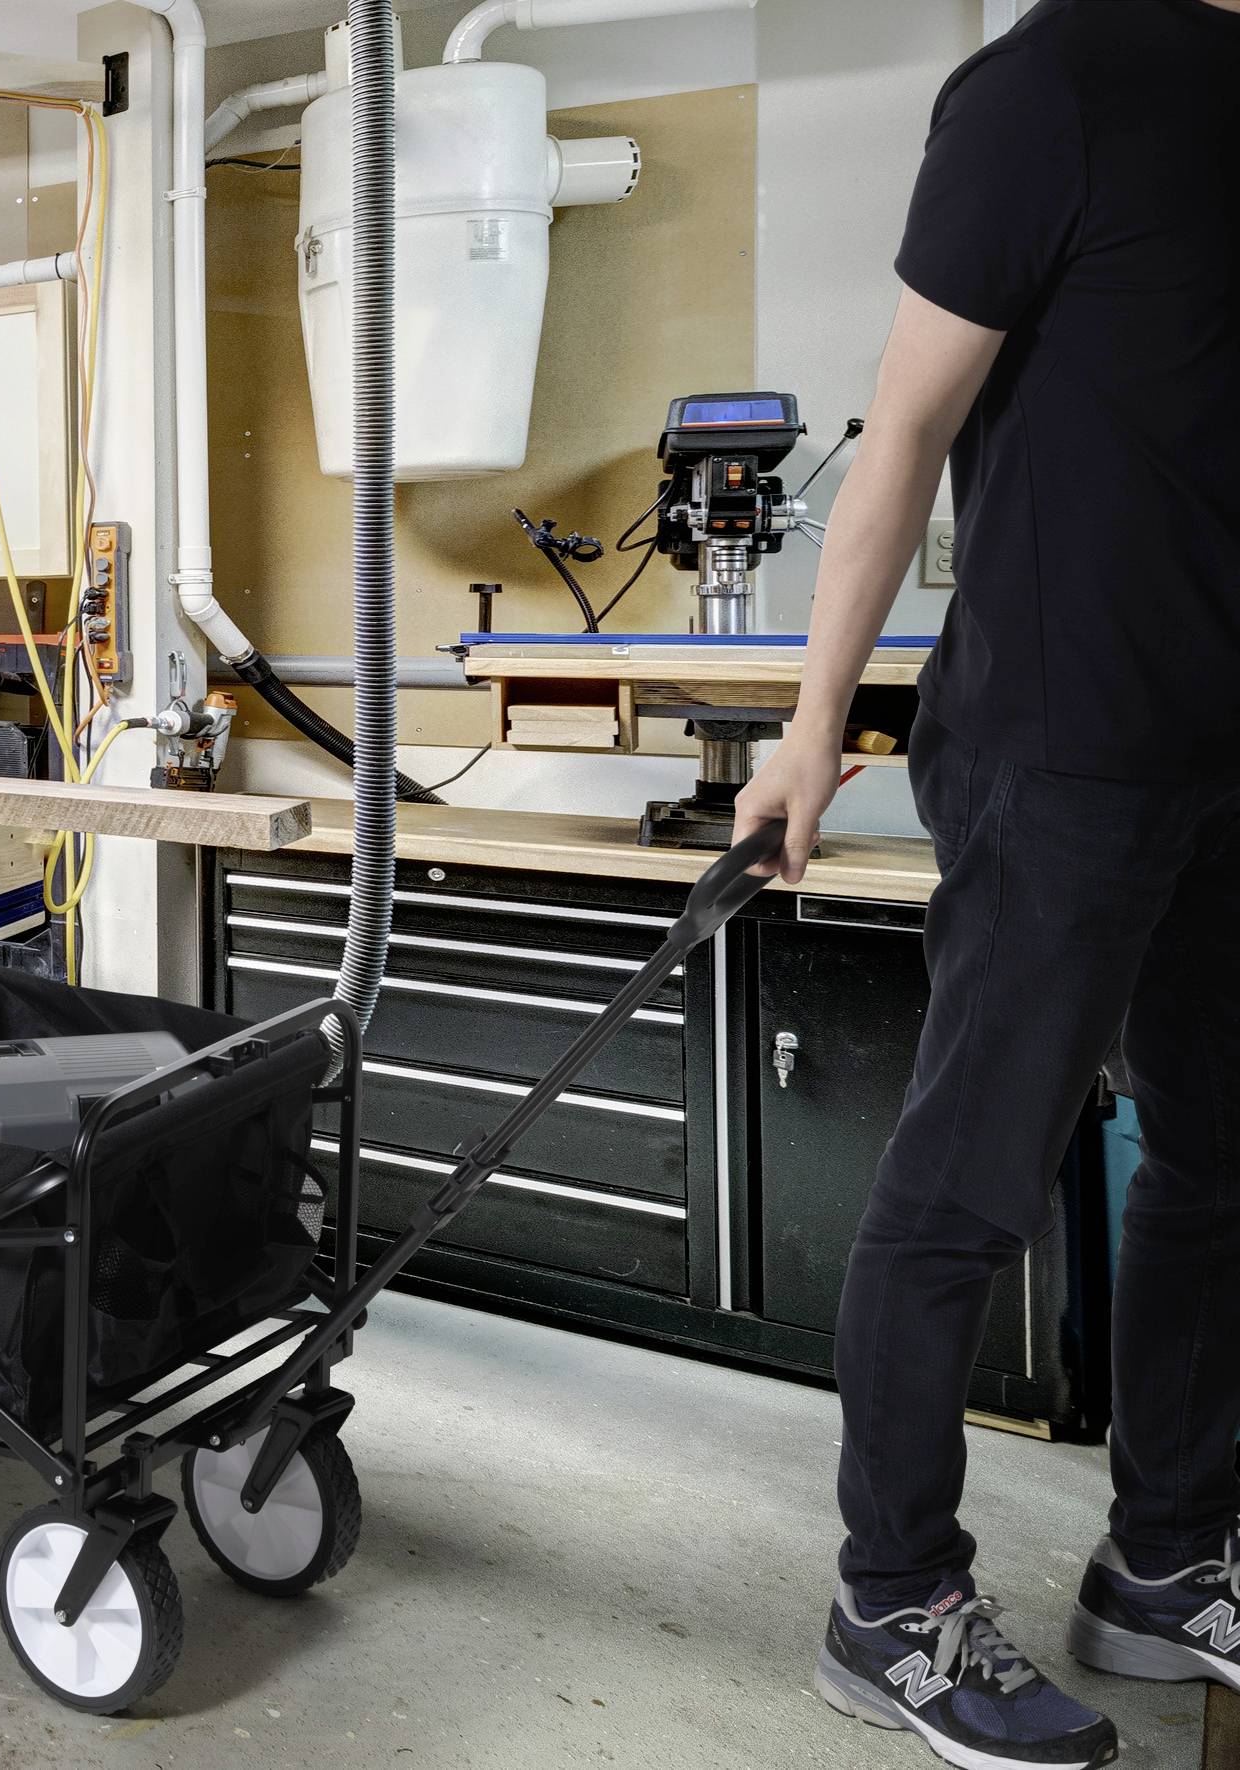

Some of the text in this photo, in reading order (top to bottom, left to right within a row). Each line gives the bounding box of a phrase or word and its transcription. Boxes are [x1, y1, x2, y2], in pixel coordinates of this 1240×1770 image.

[929, 1590, 963, 1617] alance
[1181, 1598, 1240, 1654] N
[884, 1650, 954, 1709] N
